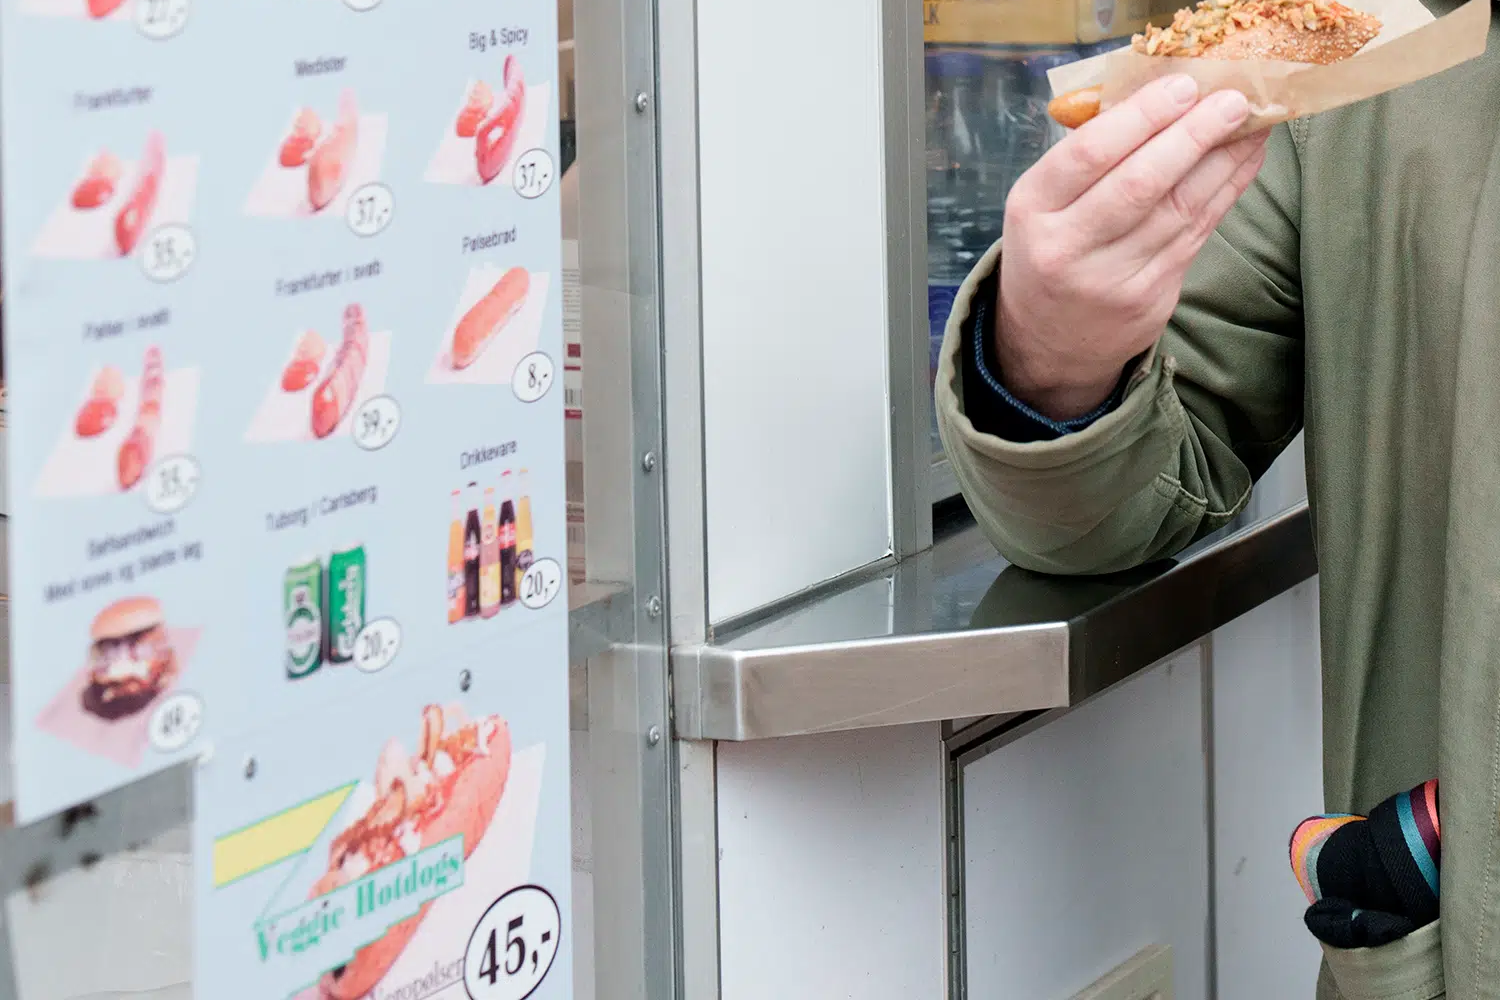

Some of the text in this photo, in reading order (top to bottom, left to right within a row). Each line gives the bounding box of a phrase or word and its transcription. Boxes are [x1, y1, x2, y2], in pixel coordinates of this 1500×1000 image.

[469, 26, 529, 53] Big & Spicy
[518, 161, 549, 193] 37,-
[355, 195, 389, 224] 37,-
[275, 267, 342, 298] Frankfurter
[526, 365, 548, 392] 8,-
[363, 409, 394, 439] 39,-
[460, 439, 517, 471] Drikkevare
[320, 484, 377, 516] Carlsberg
[523, 571, 557, 604] 20,-
[355, 852, 460, 921] Hotdogs
[479, 915, 551, 985] 45,-
